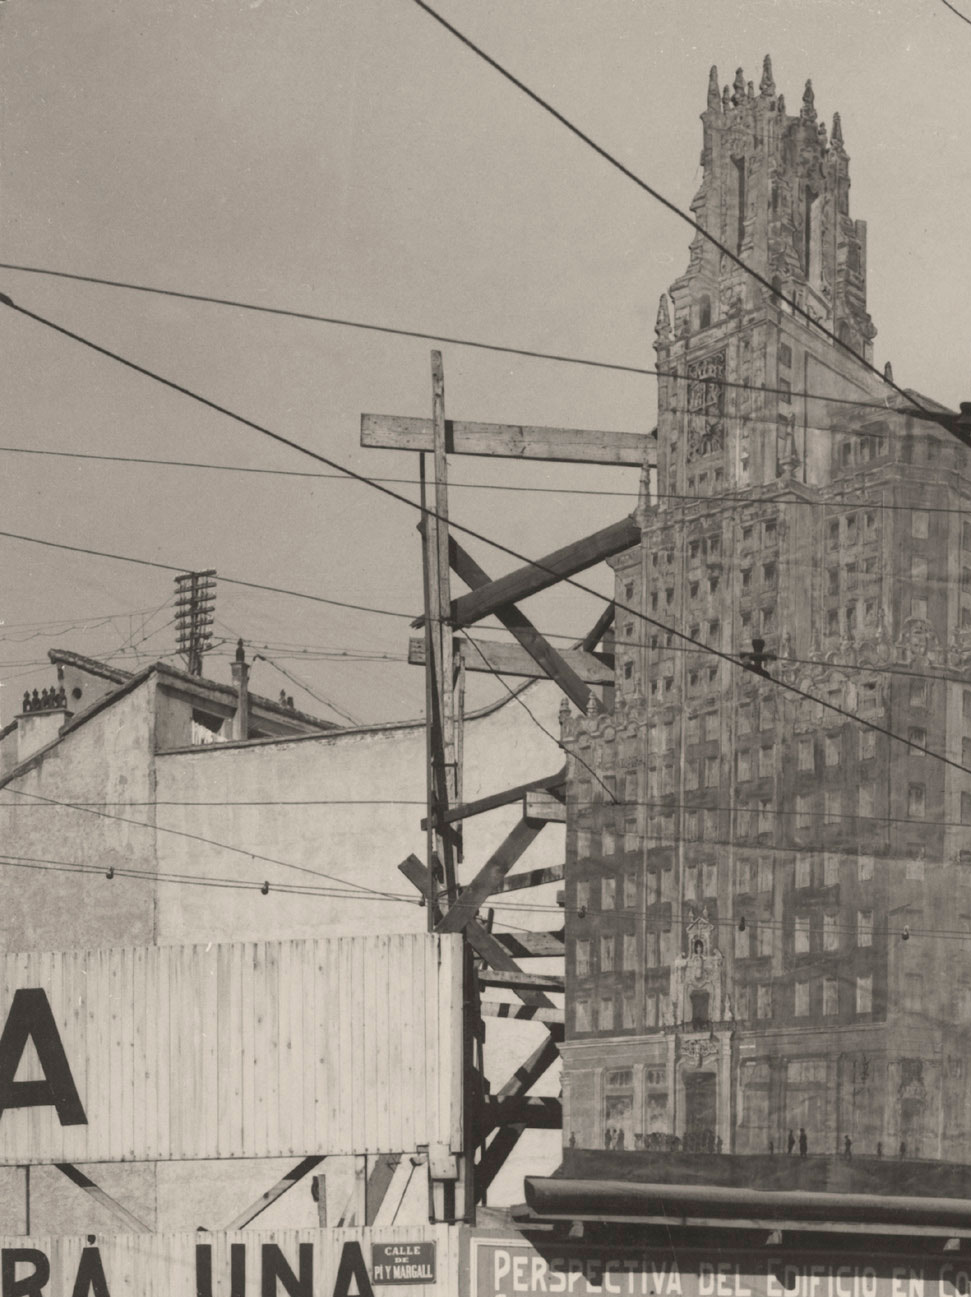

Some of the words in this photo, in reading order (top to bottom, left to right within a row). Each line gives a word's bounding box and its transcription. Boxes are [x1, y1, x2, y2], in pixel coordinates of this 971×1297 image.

[0, 987, 88, 1126] A
[384, 1246, 421, 1256] CALLE
[394, 1256, 410, 1264] DE
[385, 1265, 392, 1280] Y
[393, 1264, 433, 1280] MARGALL
[699, 1260, 752, 1297] DEL
